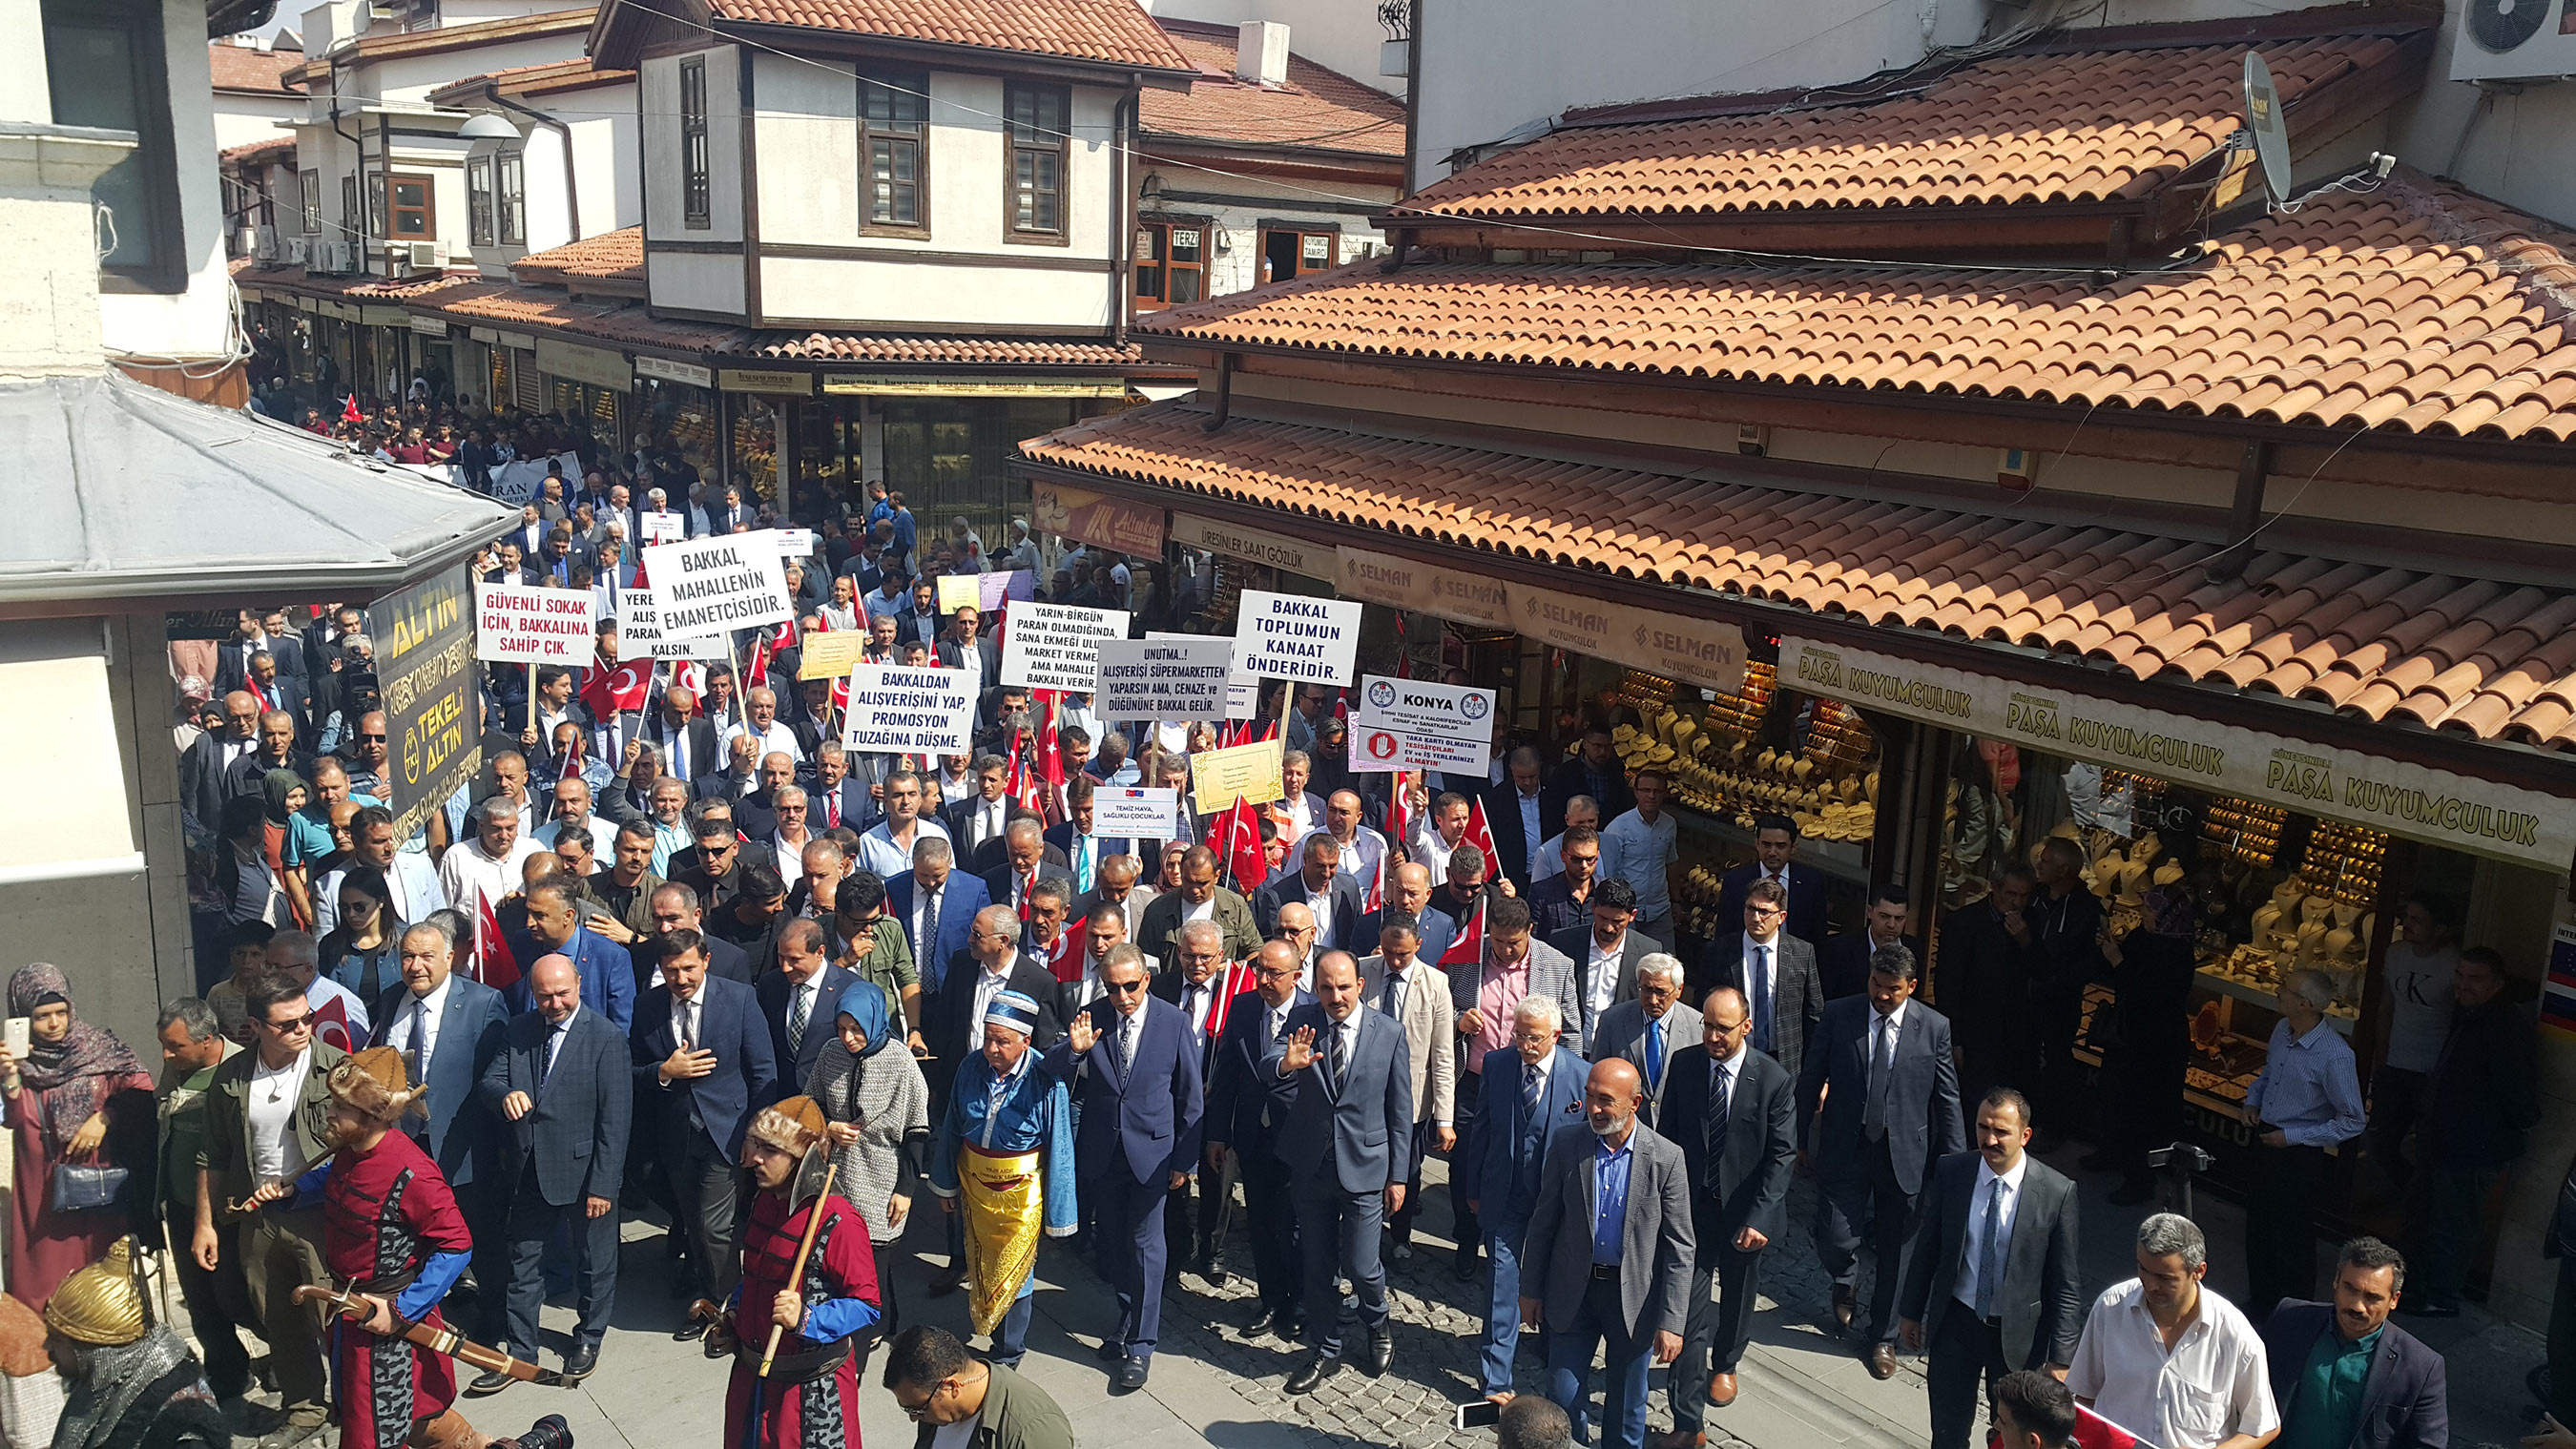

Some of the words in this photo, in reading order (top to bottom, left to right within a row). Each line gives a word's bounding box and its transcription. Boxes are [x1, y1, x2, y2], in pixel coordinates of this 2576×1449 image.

[496, 483, 528, 496] RAN
[1201, 527, 1241, 553] ÜRESİNLER
[1244, 541, 1266, 559] SAAT
[1267, 546, 1304, 569] GÖZLÜK
[681, 547, 746, 573] BAKKAL,
[672, 569, 766, 602] MAHALLENİN
[1360, 563, 1411, 588] SELMAN
[487, 591, 541, 611] GÜVENLİ
[546, 598, 587, 615] SOKAK
[625, 593, 654, 606] YERE
[1446, 580, 1507, 606] SELMAN
[632, 611, 656, 625] ALIŞ
[663, 592, 785, 631] EMANETÇİSİDİR.
[1035, 607, 1104, 623] YARIN-BİRGÜN
[1272, 599, 1329, 619] BAKKAL
[1543, 603, 1609, 634] SELMAN
[392, 581, 458, 659] ALTIN
[483, 611, 514, 634] İÇİN,
[519, 617, 589, 636] BAKKALINA
[1017, 619, 1048, 631] PARAN
[1050, 623, 1118, 639] OLMADIĞINDA,
[1256, 617, 1340, 641] TOPLUMUN
[499, 635, 540, 653] SAHİP
[544, 640, 570, 656] ÇIK.
[1015, 632, 1041, 644] SANA
[1044, 634, 1079, 648] EKMEĞİ
[1082, 638, 1099, 650] ULU
[1266, 639, 1325, 658] KANAAT
[1548, 627, 1598, 650] KUYUMCULUK
[1652, 631, 1731, 665] SELMAN
[651, 644, 695, 656] KALSIN.
[1025, 647, 1063, 659] MARKET
[1065, 653, 1098, 663] VERME
[1144, 648, 1188, 661] UNUTMA..!
[1030, 660, 1051, 672] AMA
[1054, 663, 1096, 675] MAHALLE
[1103, 663, 1148, 679] ALIŞVERİŞİ
[1150, 663, 1225, 678] SÜPERMARKETTEN
[1246, 653, 1340, 680] ÖNDERİDİR.
[1661, 656, 1718, 681] KUYUMCULUK
[882, 673, 950, 689] BAKKALDAN
[1027, 673, 1064, 686] BAKKALI
[1067, 675, 1097, 688] VERİR.
[1109, 682, 1150, 695] YAPARSIN
[1152, 684, 1173, 696] AMA,
[1174, 683, 1206, 695] CENAZE
[1208, 685, 1217, 695] ve
[1798, 655, 1842, 688] PAŞA
[1849, 667, 1972, 719] KUYUMCULUK
[858, 691, 939, 710] ALIŞVERİŞİNİ
[943, 695, 966, 713] YAP,
[1109, 696, 1154, 712] DÜĞÜNÜNE
[1157, 699, 1186, 712] BAKKAL
[1189, 698, 1215, 712] GELİR.
[1403, 693, 1453, 711] KONYA
[417, 686, 464, 743] TEKELİ
[872, 712, 948, 728] PROMOSYON
[1419, 721, 1459, 731] SANATKARLAR
[426, 721, 462, 776] ALTIN
[852, 728, 911, 746] TUZAĞINA
[916, 731, 961, 750] DÜŞME.
[1404, 742, 1455, 754] TESİSATÇILARI
[1405, 735, 1423, 743] YAKA
[1445, 740, 1477, 749] OLMAYAN
[2006, 703, 2061, 740] PAŞA
[2069, 716, 2224, 776] KUYUMCULUK
[1404, 756, 1442, 767] ALMAYIN!
[1423, 750, 1431, 758] İŞ
[1433, 754, 1475, 763] YERLERİNİZE
[2266, 760, 2335, 802] PAŞA
[2344, 776, 2540, 847] KUYUMCULUK
